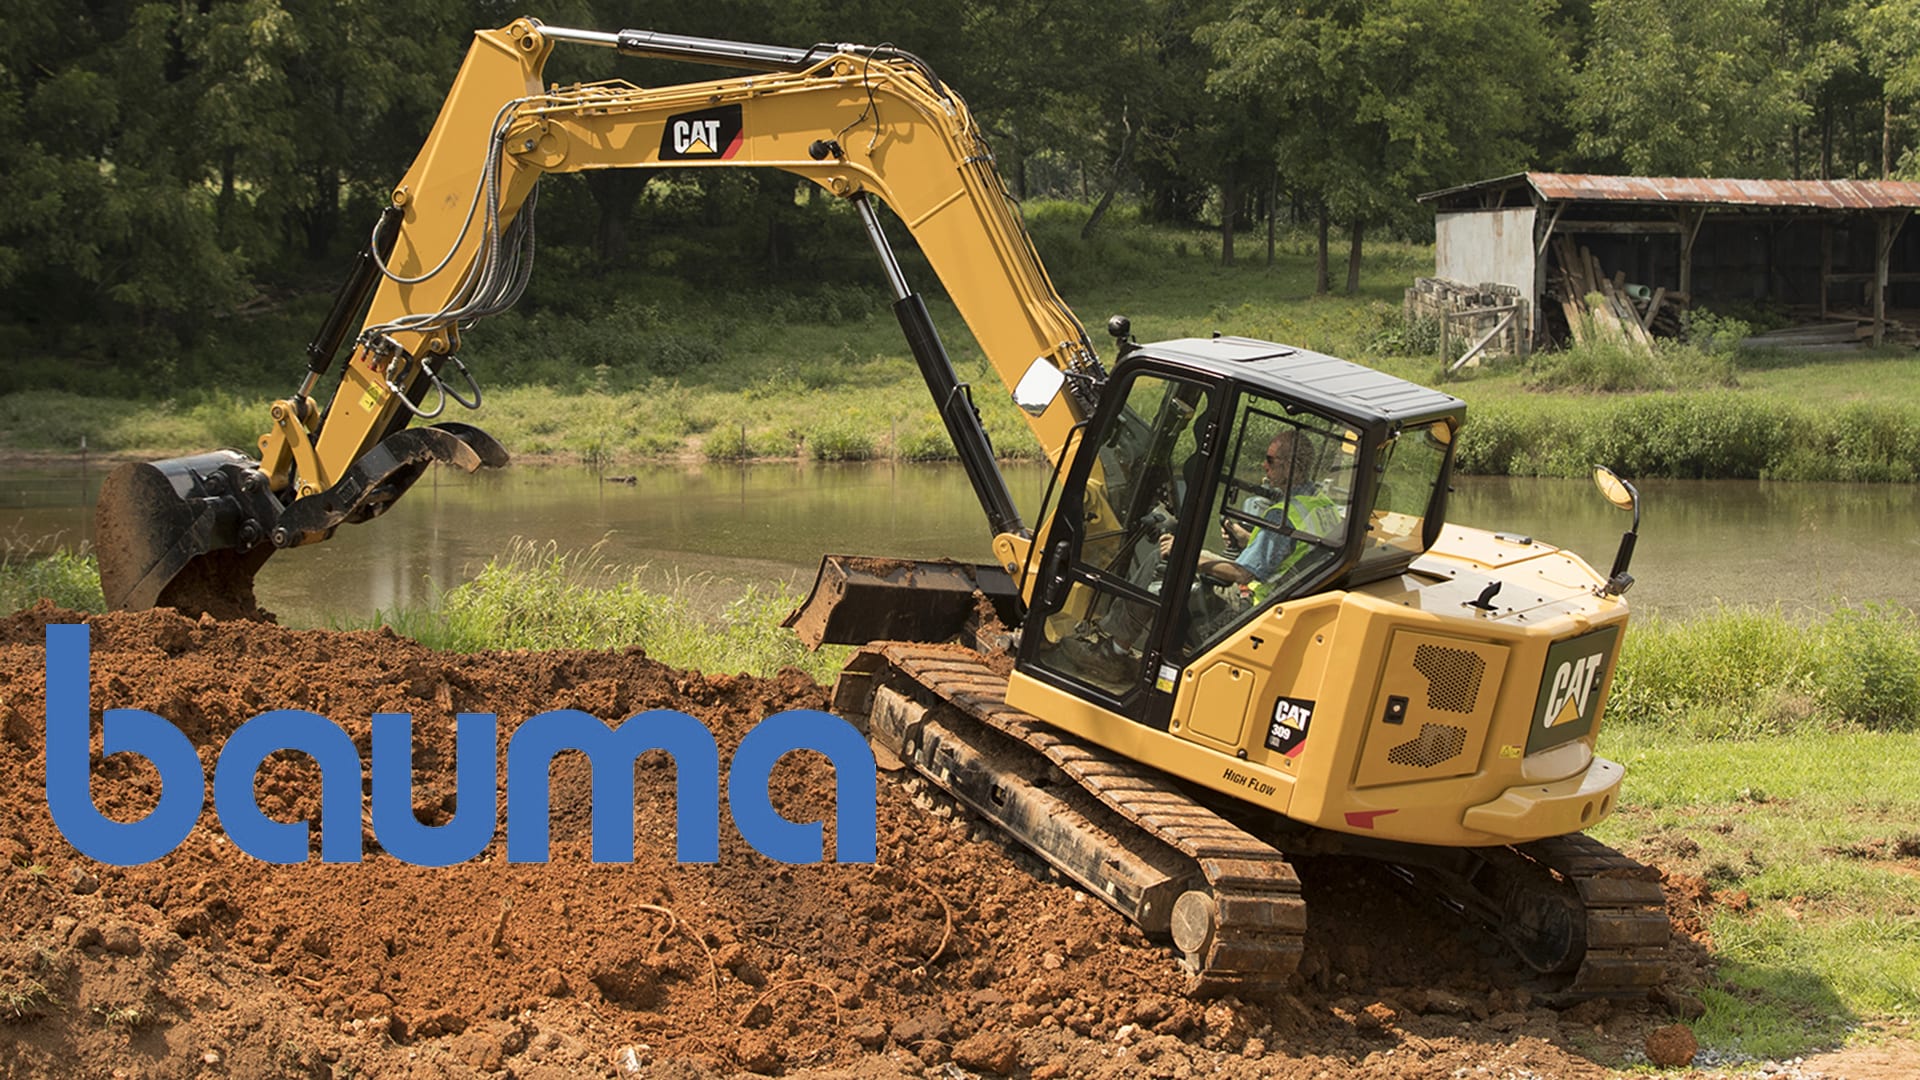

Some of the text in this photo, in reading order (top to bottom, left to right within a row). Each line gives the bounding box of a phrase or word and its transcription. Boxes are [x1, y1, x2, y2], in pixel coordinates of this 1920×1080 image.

[673, 120, 720, 154] CAT
[1543, 653, 1603, 729] CAT
[1275, 700, 1311, 731] CAT
[1271, 724, 1291, 740] 309
[1222, 768, 1276, 796] HIGH FLOW
